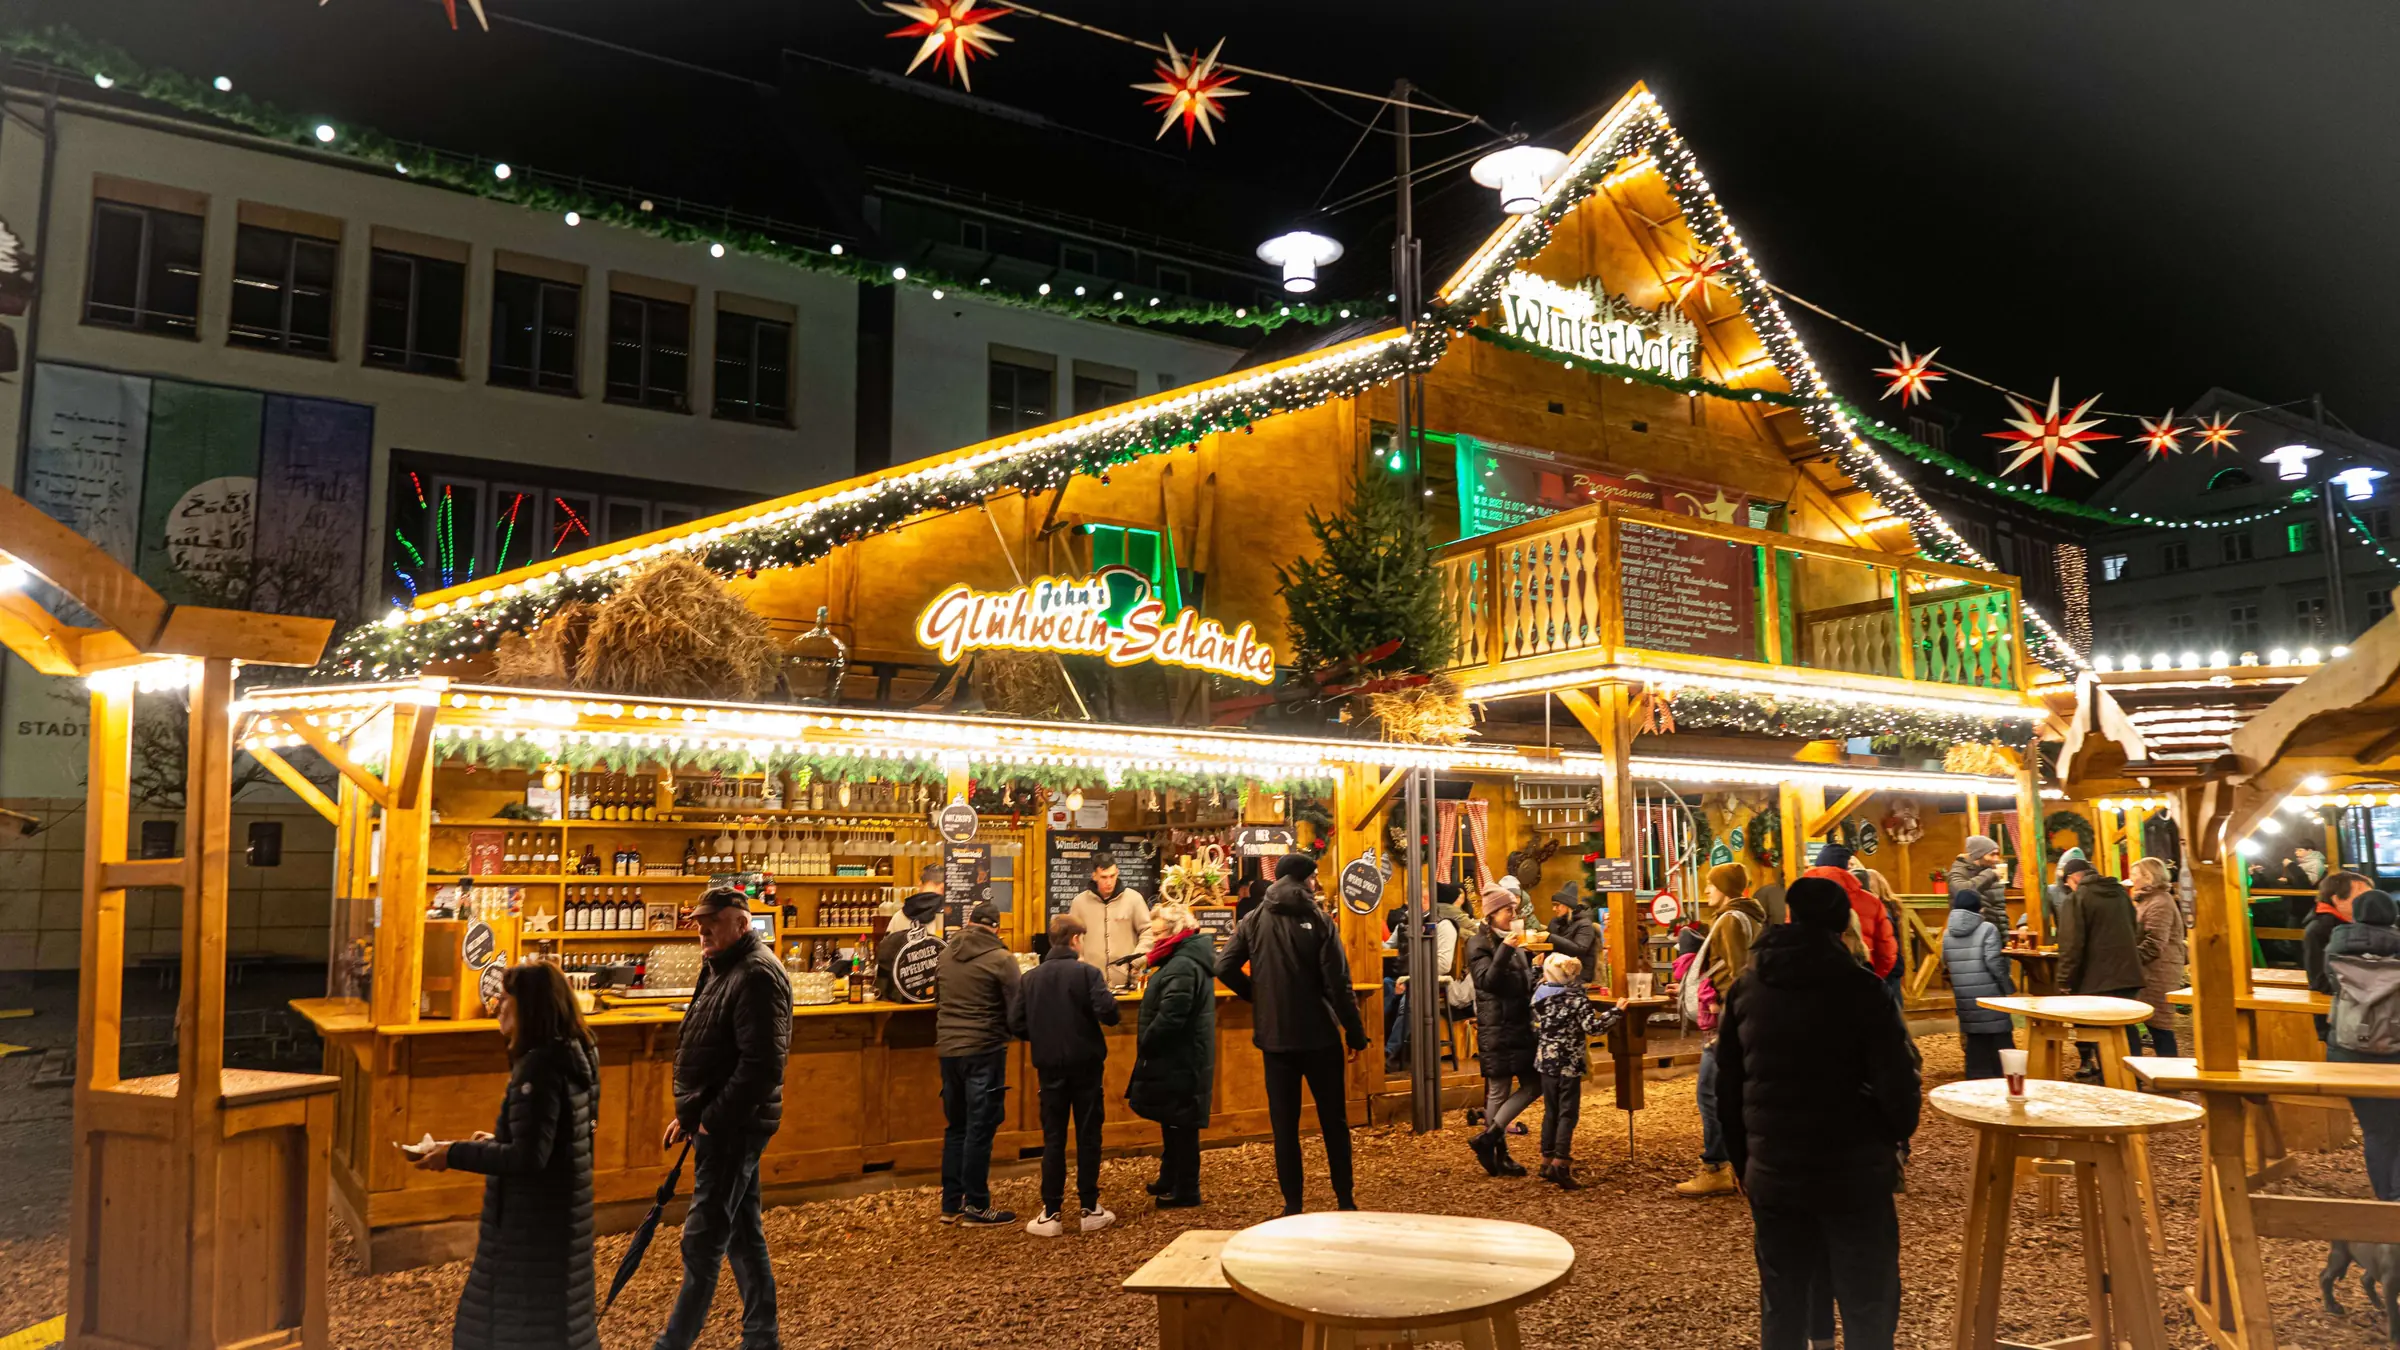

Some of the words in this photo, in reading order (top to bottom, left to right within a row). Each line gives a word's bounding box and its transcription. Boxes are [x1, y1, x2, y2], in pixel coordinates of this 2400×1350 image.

[1573, 474, 1655, 500] Programm
[926, 589, 1273, 676] Glühwein-Schänke
[1055, 840, 1099, 850] WinterWald
